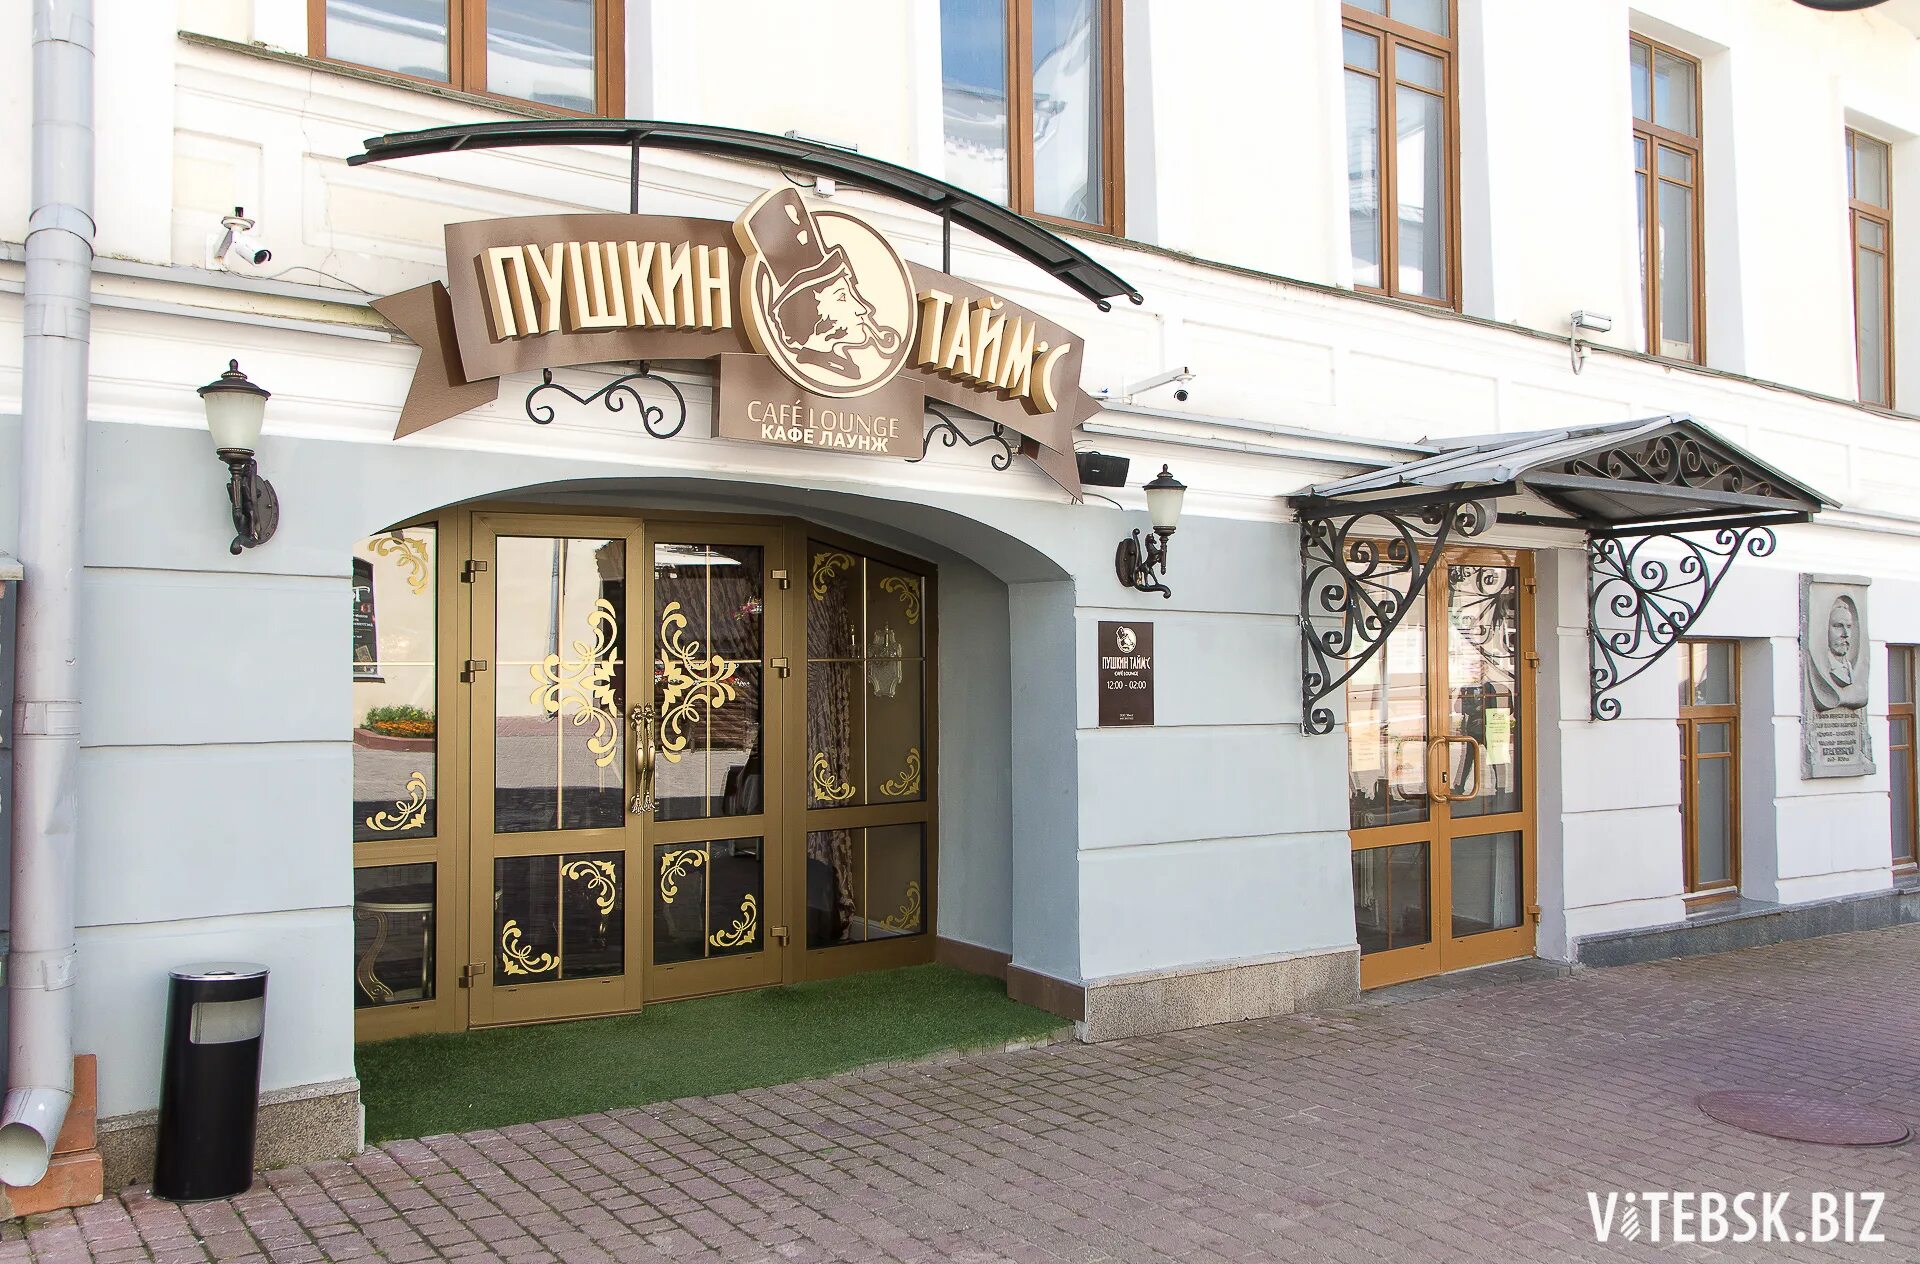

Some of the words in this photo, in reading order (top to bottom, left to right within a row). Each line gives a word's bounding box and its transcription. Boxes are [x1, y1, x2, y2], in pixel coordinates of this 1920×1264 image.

[481, 240, 732, 339] ПУШКИН
[747, 400, 803, 427] CAFÉ
[808, 408, 899, 438] LOUNGE
[761, 423, 815, 444] КАФЕ
[818, 431, 889, 453] ЛАУНЖ
[1102, 656, 1129, 670] ПУШКИН
[1106, 680, 1124, 690] 12:00
[1128, 680, 1147, 690] 02:00
